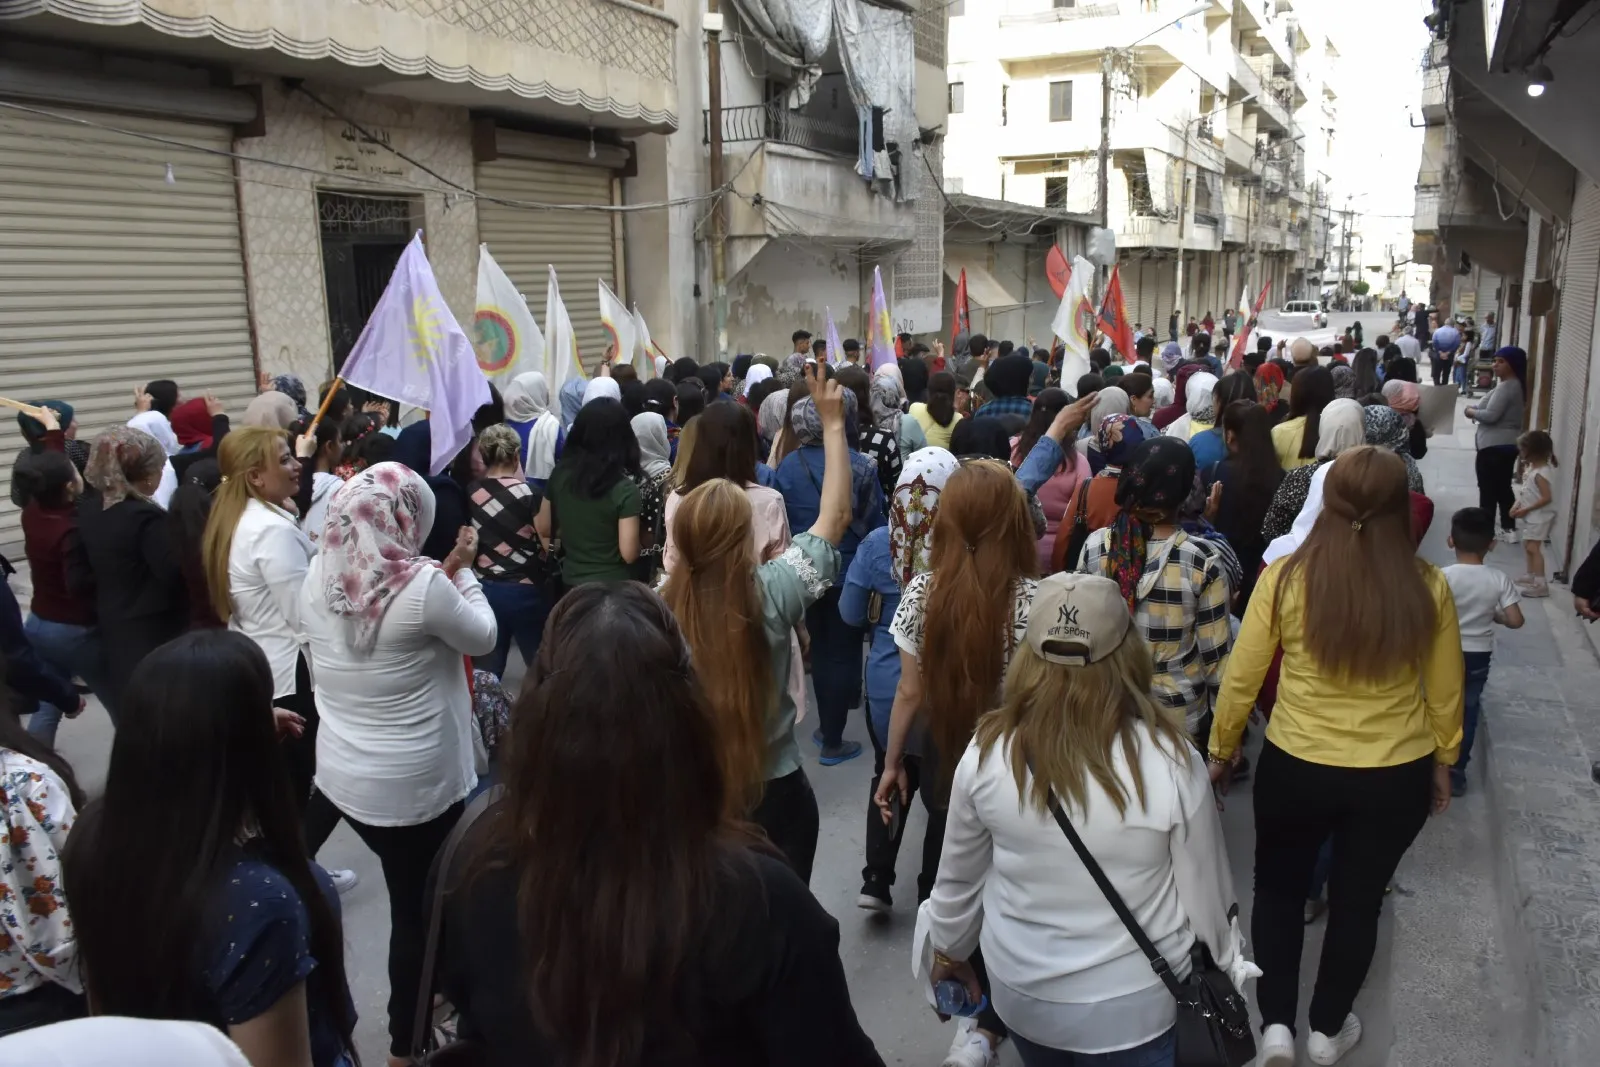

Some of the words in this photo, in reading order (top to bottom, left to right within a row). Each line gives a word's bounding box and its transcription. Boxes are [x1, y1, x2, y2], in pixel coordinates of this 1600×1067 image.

[1057, 604, 1079, 625] NY
[1047, 626, 1061, 637] NEW
[1064, 626, 1090, 639] SPORT
